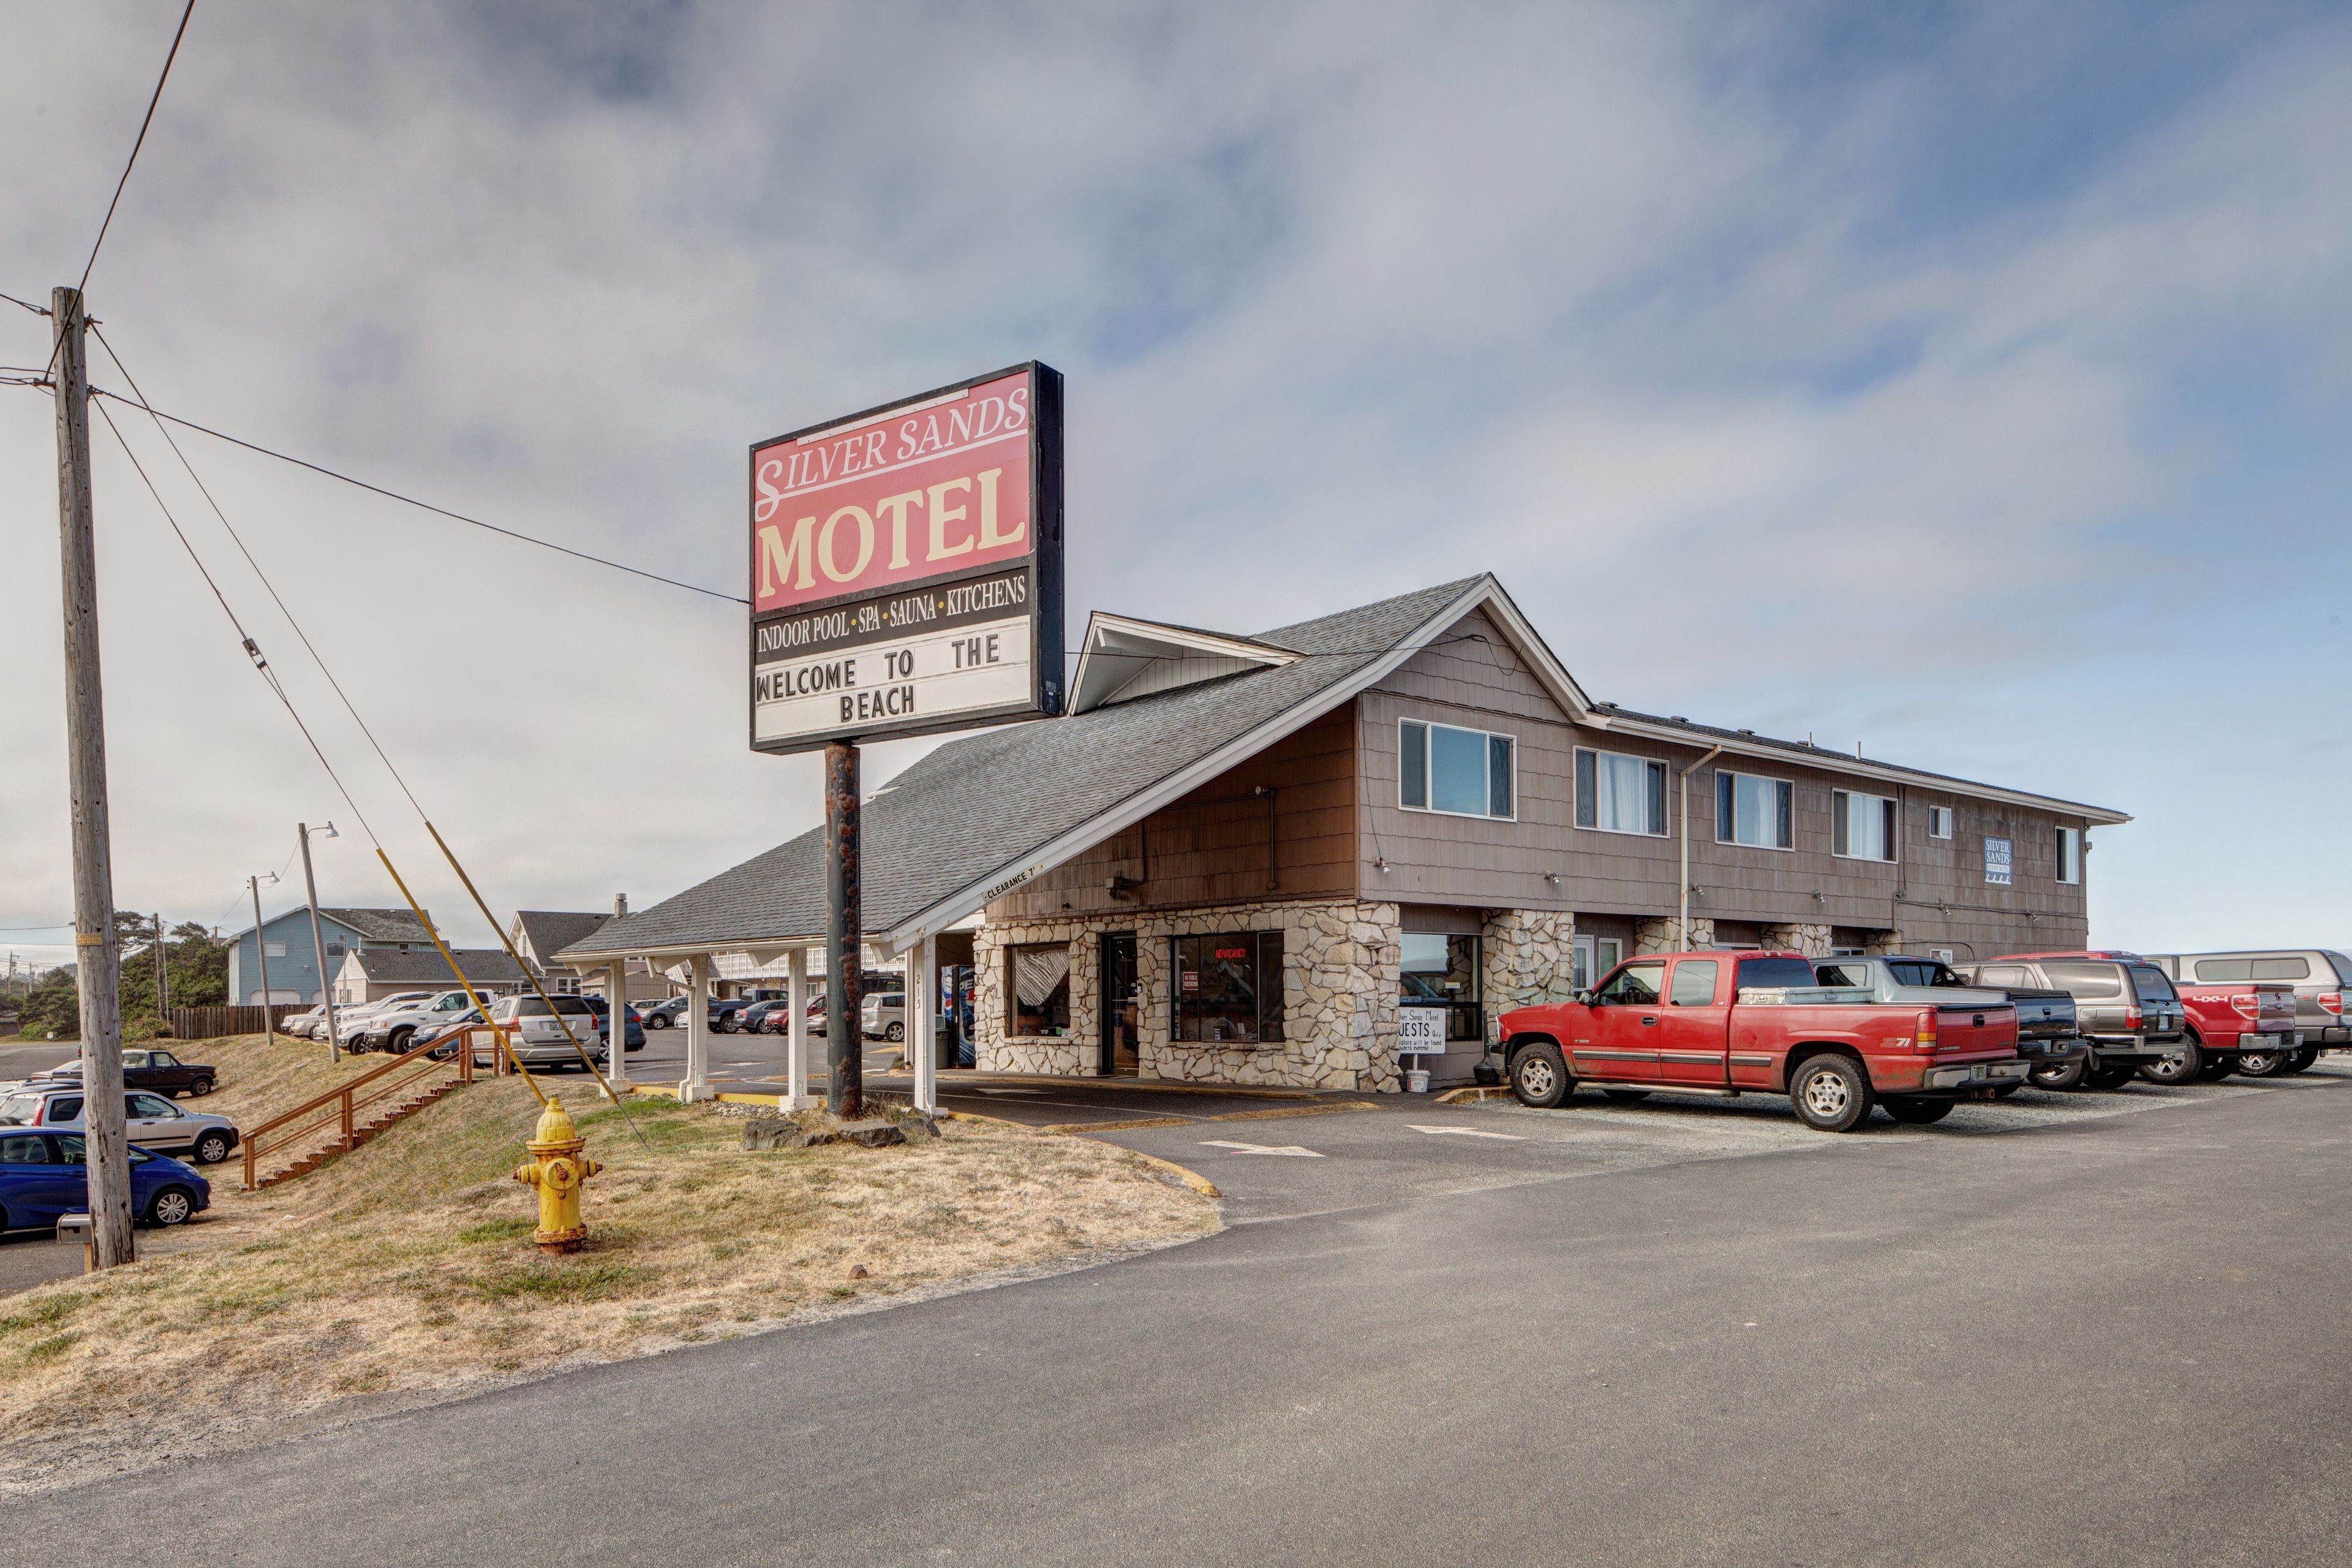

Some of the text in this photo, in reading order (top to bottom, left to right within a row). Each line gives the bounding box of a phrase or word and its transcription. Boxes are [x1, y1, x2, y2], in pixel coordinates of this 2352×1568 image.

[755, 387, 1028, 522] SILVER SANDS
[758, 468, 1026, 598] MOTEL
[758, 575, 1026, 653] INDOOR POOL SPA SAUNA KITCHENS
[756, 633, 1000, 703] WELCOME TO THE
[840, 685, 914, 723] BEACH
[1986, 839, 2010, 853] SILVER
[1986, 851, 2010, 864] SANDS
[987, 872, 1027, 899] CLEARANCE
[1215, 948, 1246, 959] NO VACANCY
[959, 978, 974, 992] PE
[1409, 1009, 1422, 1021] Sands
[1426, 1011, 1439, 1021] Motel
[1399, 1023, 1429, 1037] UESTS
